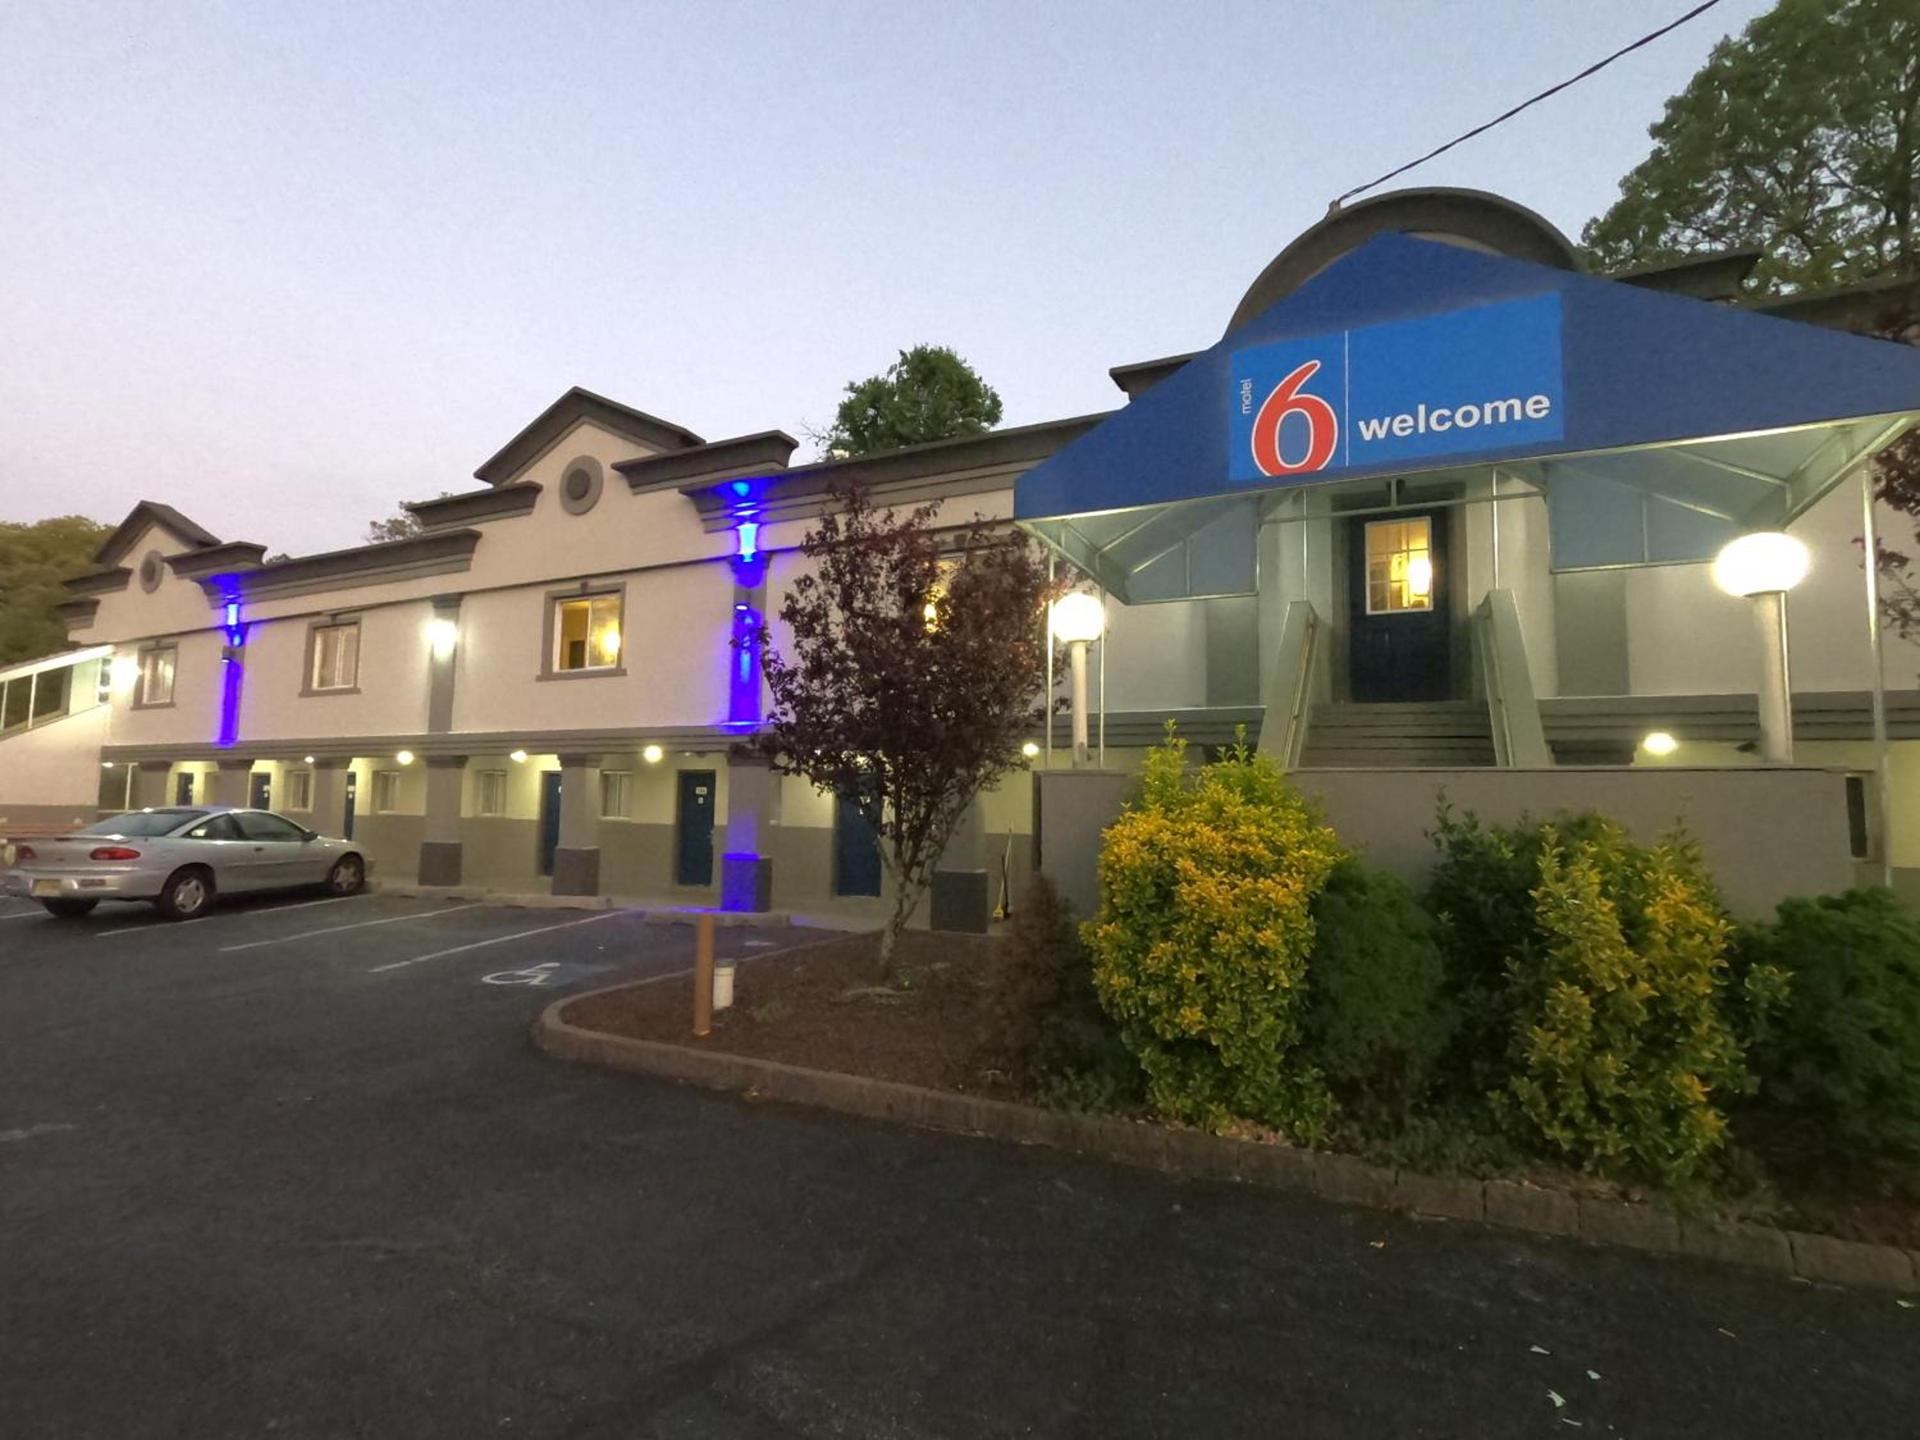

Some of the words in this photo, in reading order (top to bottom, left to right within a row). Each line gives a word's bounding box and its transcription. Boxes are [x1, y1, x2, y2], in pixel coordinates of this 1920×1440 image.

[1240, 378, 1252, 415] motel
[1251, 360, 1338, 476] 6
[1358, 394, 1551, 441] welcome
